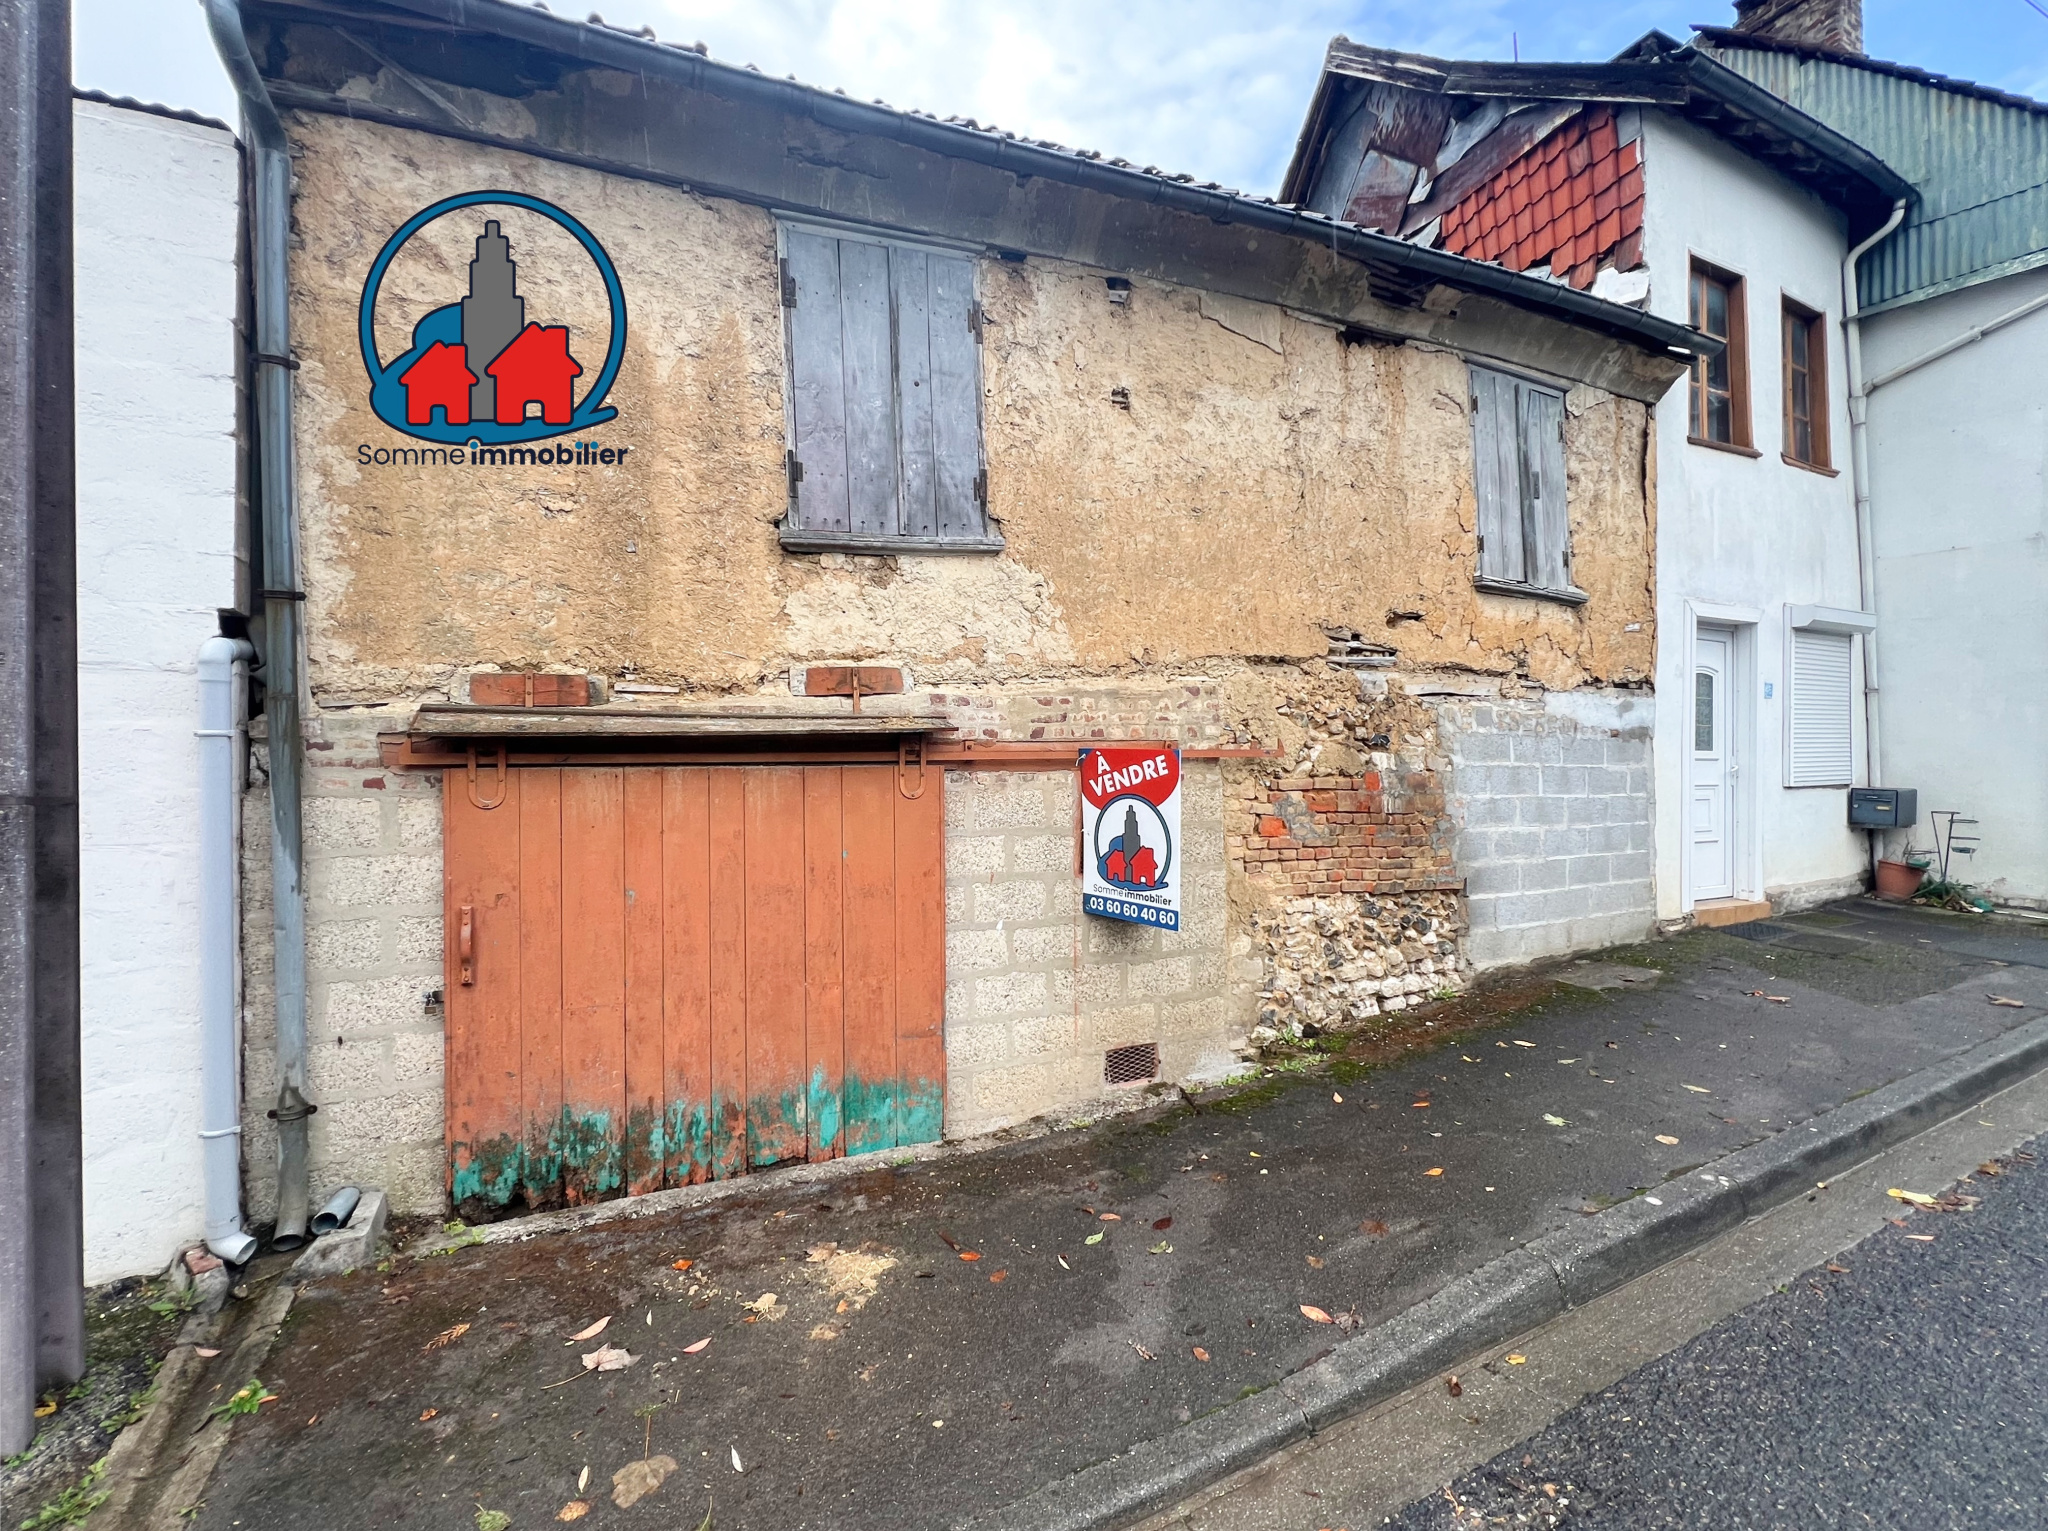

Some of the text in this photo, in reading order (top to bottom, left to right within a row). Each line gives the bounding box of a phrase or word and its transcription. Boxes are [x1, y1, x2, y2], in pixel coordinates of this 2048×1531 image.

[1088, 754, 1169, 797] VENDRE
[1095, 750, 1111, 775] À
[1093, 883, 1172, 906] Somme immobilier
[1090, 896, 1175, 926] 03 60 60 40 60
